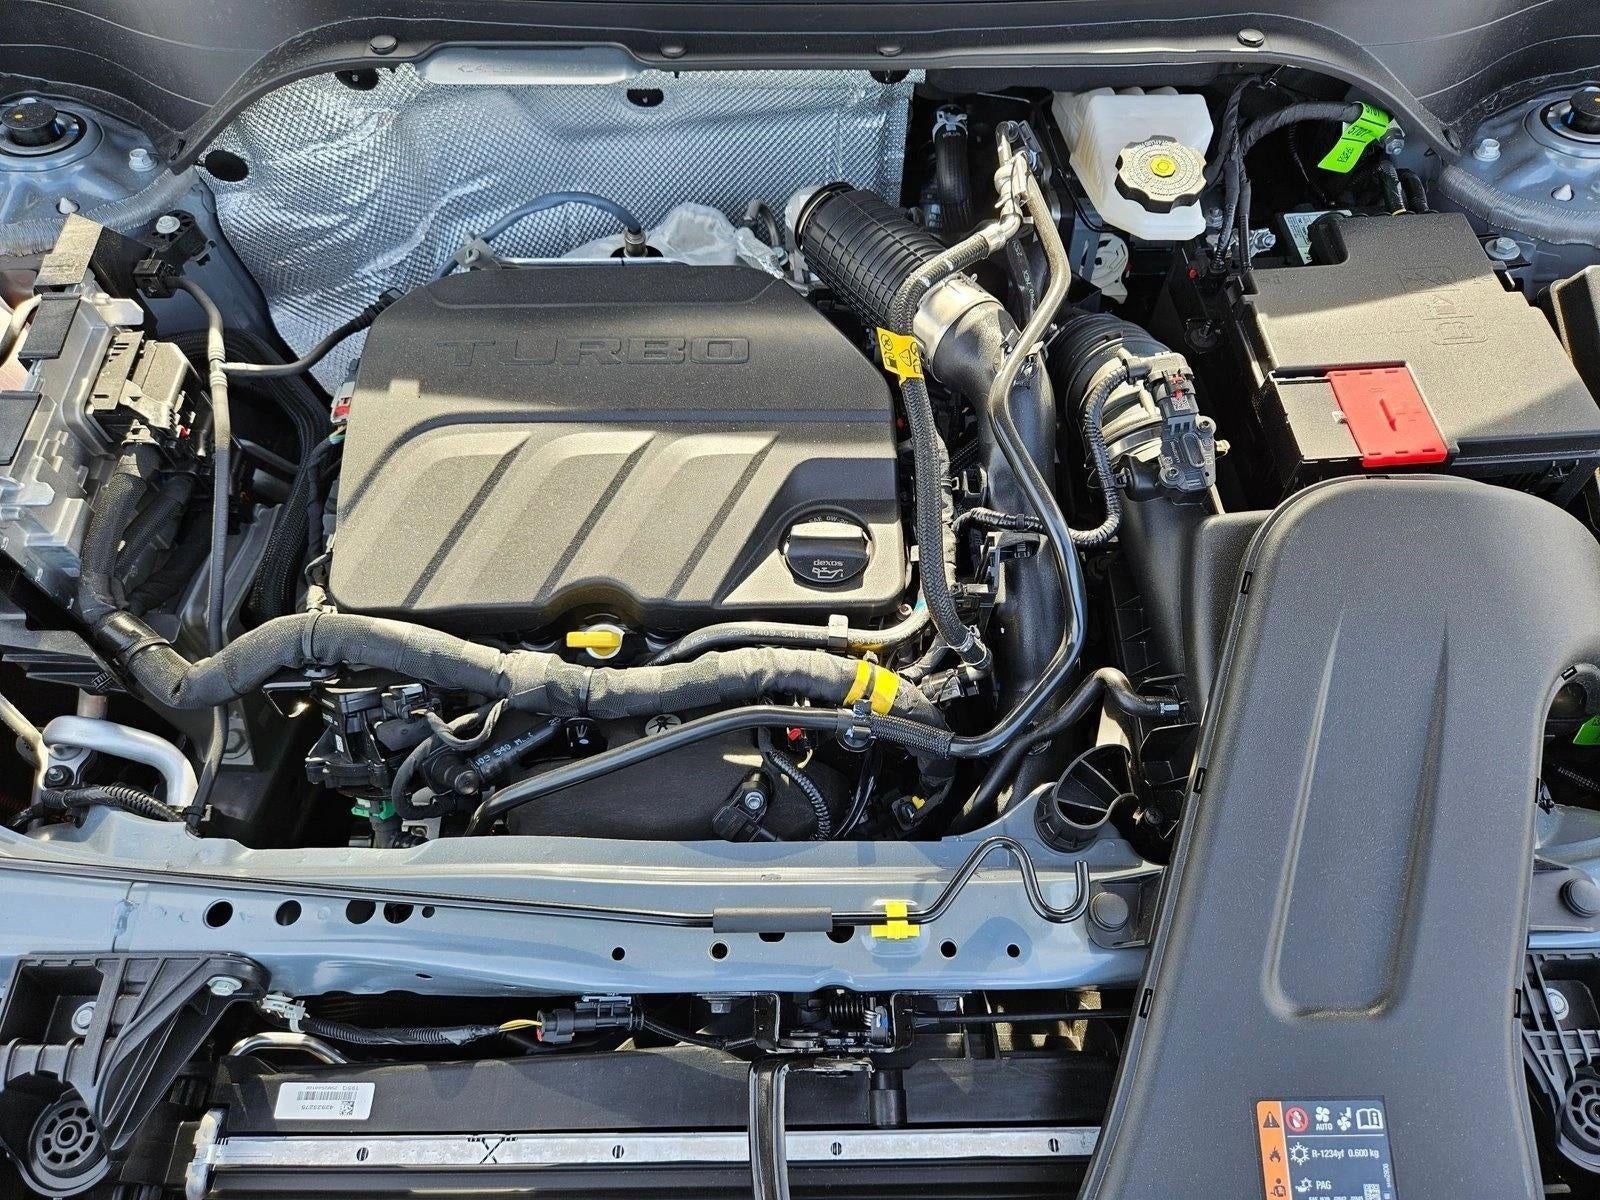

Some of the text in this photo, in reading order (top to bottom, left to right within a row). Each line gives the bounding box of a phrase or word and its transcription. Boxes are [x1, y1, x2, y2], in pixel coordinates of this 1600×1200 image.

[436, 337, 750, 367] TURBO
[813, 559, 844, 567] dexos
[1315, 1122, 1334, 1132] AUTO
[1347, 1148, 1369, 1158] 0.600
[1370, 1148, 1380, 1160] kg
[1315, 1180, 1333, 1190] PAG
